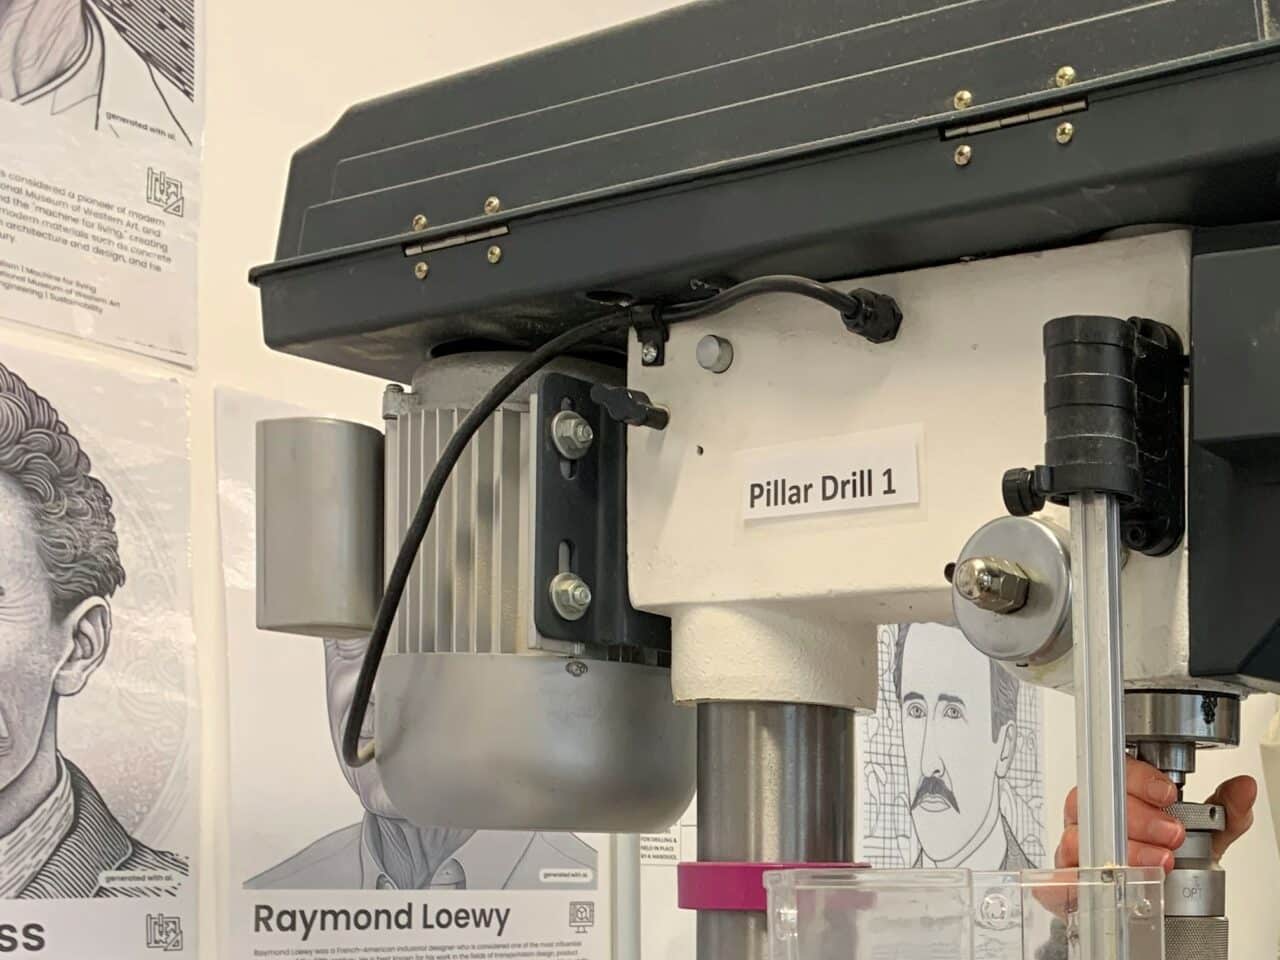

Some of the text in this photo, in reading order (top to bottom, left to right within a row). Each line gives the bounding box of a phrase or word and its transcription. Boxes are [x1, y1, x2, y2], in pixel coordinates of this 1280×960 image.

[8, 171, 66, 197] considered
[77, 193, 114, 213] pioneer
[117, 204, 126, 215] of
[129, 208, 164, 227] modern
[25, 188, 68, 210] Museum
[72, 203, 81, 213] of
[83, 206, 124, 227] Western
[143, 225, 160, 238] and
[5, 219, 68, 246] architecture
[70, 238, 89, 253] and
[129, 257, 147, 270] and
[13, 197, 29, 210] the
[82, 218, 95, 229] for
[129, 232, 168, 254] creating
[42, 218, 89, 240] materials
[92, 233, 114, 248] such
[116, 241, 128, 252] as
[130, 245, 172, 266] concrete
[750, 468, 896, 508] Pillar Drill 1
[105, 875, 145, 883] generated
[254, 902, 511, 941] Raymond Loewy
[254, 950, 290, 958] Raymond
[291, 949, 313, 957] Loewy
[428, 944, 455, 952] designer
[494, 951, 535, 960] transportation
[556, 950, 578, 958] product
